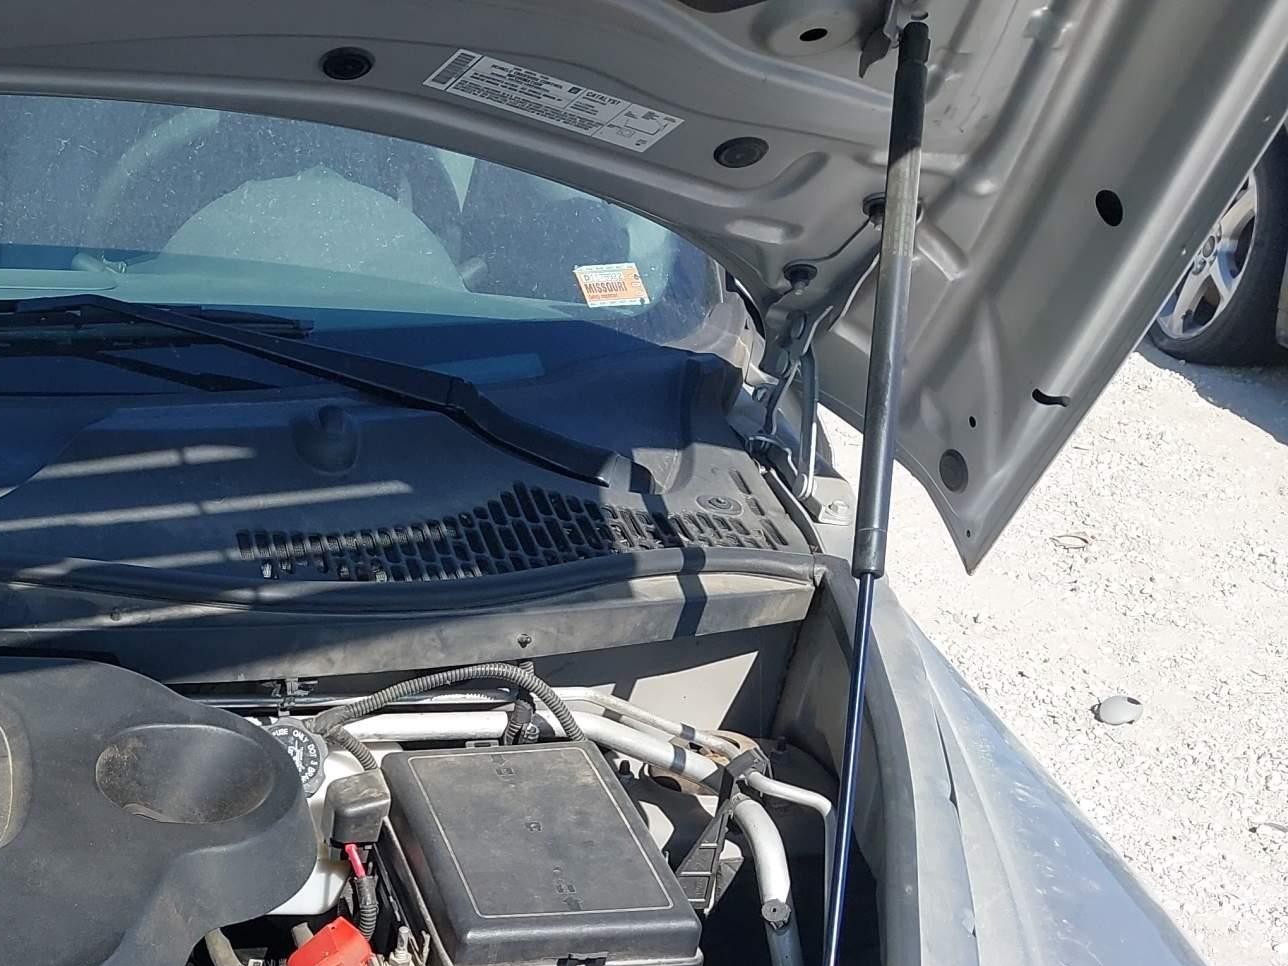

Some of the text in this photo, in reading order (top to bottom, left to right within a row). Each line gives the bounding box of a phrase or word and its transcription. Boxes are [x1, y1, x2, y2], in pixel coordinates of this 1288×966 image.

[585, 91, 622, 106] CATALYST
[584, 281, 628, 294] MISSOURI
[275, 728, 289, 737] USE
[292, 729, 310, 743] ONLY
[307, 744, 318, 758] DOT
